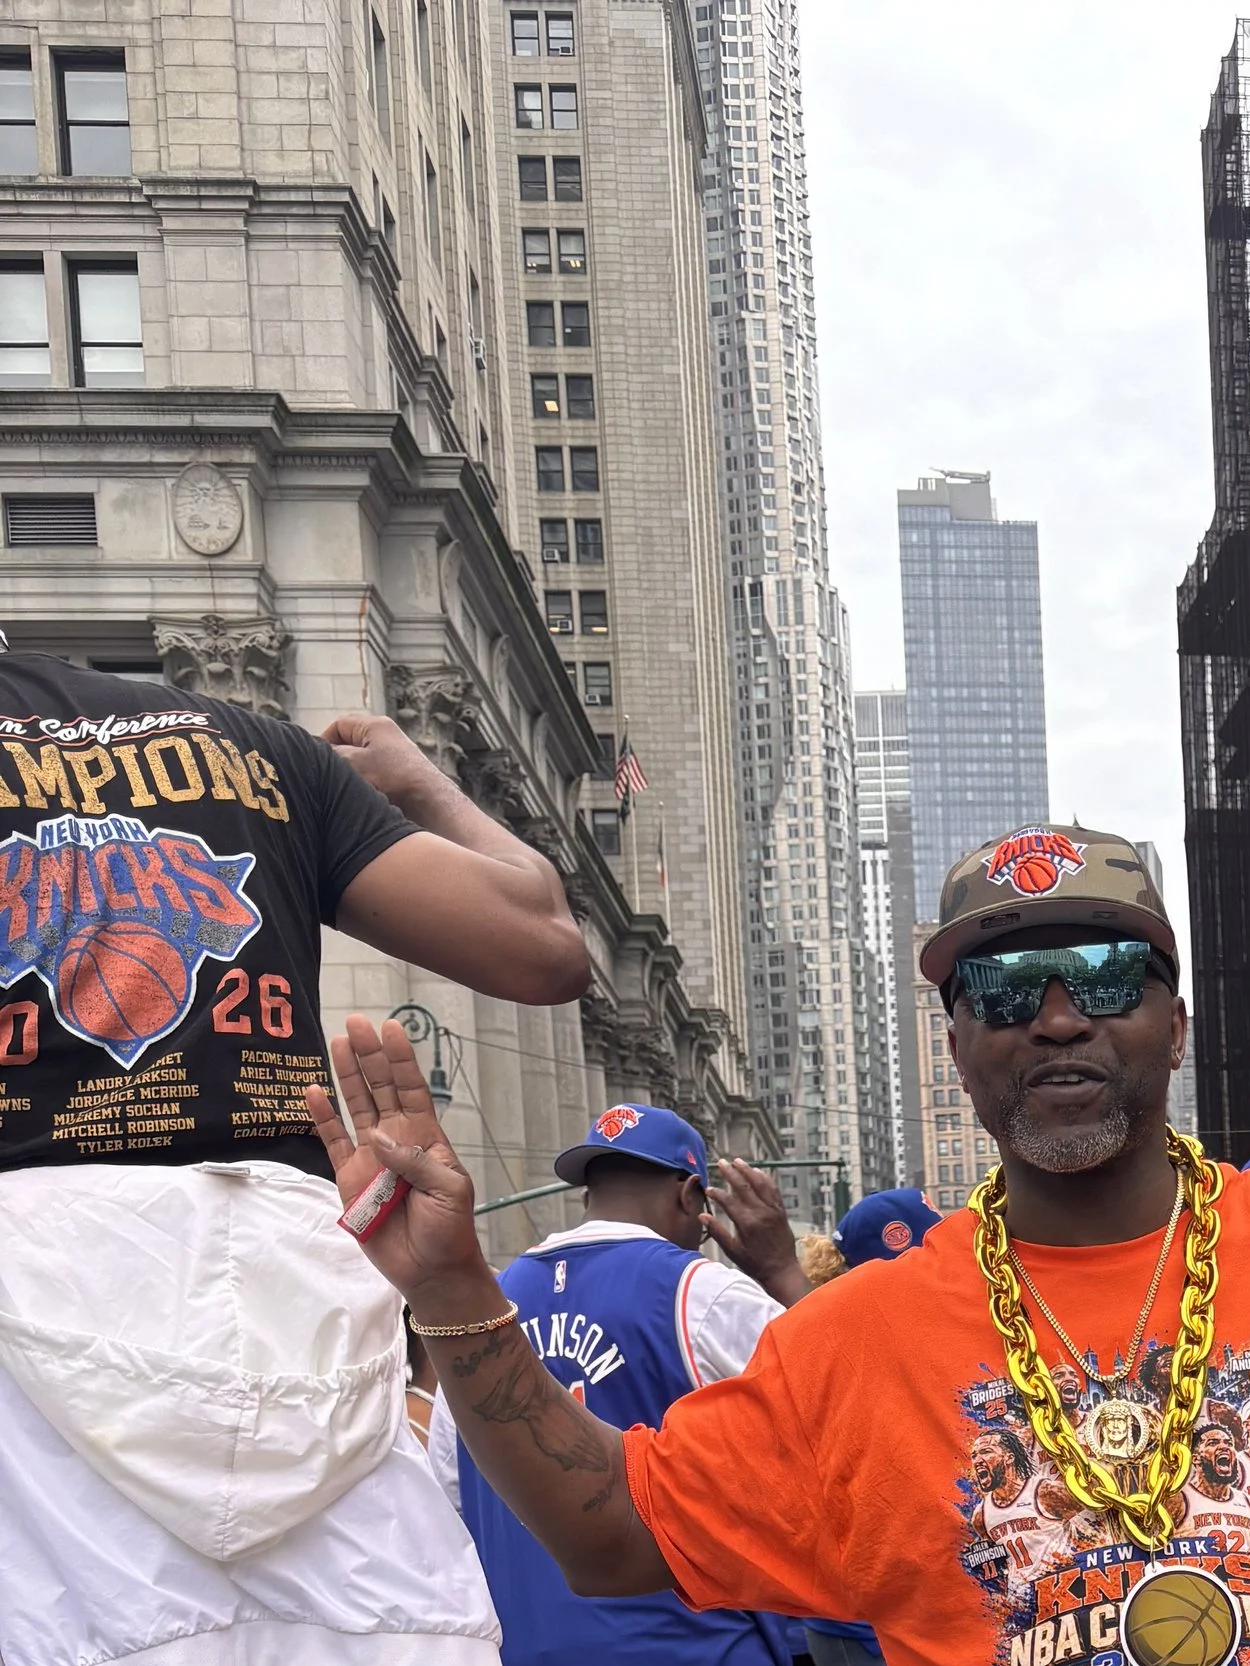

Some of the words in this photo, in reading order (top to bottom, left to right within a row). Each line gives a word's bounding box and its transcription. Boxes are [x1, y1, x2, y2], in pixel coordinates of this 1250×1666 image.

[39, 713, 209, 745] Conference
[0, 733, 290, 823] MPIONS
[40, 818, 82, 848] NEW
[85, 818, 149, 846] YORK
[988, 833, 1084, 878] KNICKS
[0, 838, 256, 943] KNICKS
[212, 967, 294, 1039] 26
[241, 1049, 283, 1066] PACOME
[284, 1054, 322, 1068] DADIET
[77, 1074, 132, 1093] LANDRY
[240, 1066, 273, 1080] ARIEL
[139, 1084, 200, 1100] MCBRIDE
[233, 1081, 289, 1096] MOHAMED
[126, 1102, 181, 1118] SOCHAN
[250, 1097, 279, 1110] TREY
[52, 1122, 124, 1140] MITCHELL
[127, 1117, 196, 1134] ROBINSON
[231, 1111, 272, 1125] KEVIN
[233, 1126, 276, 1139] COACH
[77, 1138, 124, 1154] TYLER
[127, 1135, 174, 1150] KOLEK
[519, 1312, 626, 1385] UNSON
[971, 1384, 1014, 1407] BRIDGES
[985, 1397, 1008, 1420] 25
[1007, 1516, 1041, 1534] YORK
[1192, 1512, 1221, 1530] NEW
[967, 1545, 1007, 1568] BRUNSON
[1006, 1536, 1034, 1570] 11
[1086, 1545, 1135, 1568] NEW
[1163, 1540, 1208, 1556] ORK
[982, 1560, 998, 1580] 11
